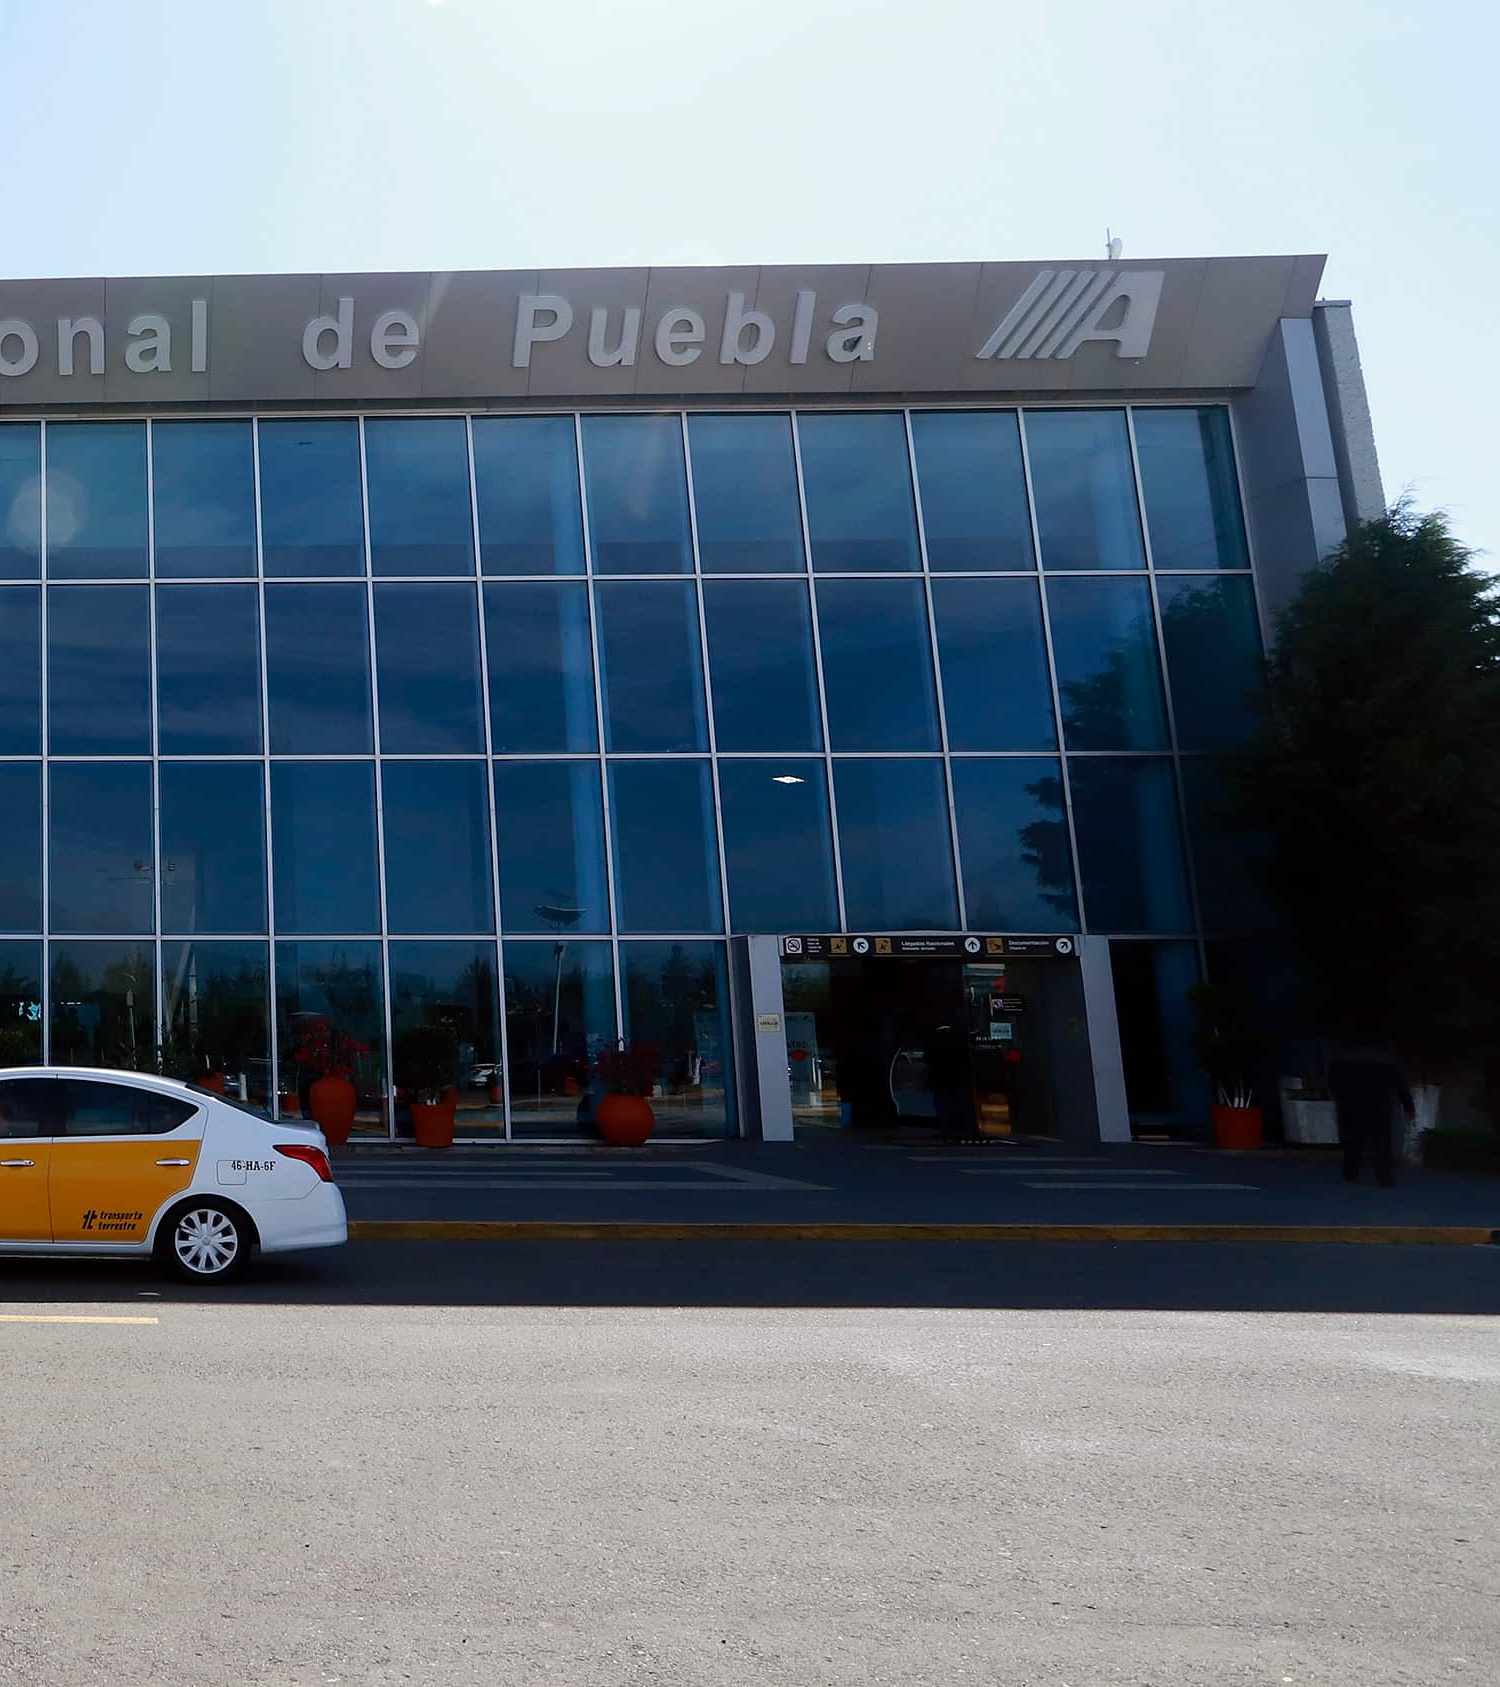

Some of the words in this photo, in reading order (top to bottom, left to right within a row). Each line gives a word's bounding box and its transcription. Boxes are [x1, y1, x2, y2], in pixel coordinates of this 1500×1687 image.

[301, 296, 421, 370] de
[512, 290, 880, 368] Puebla
[231, 1160, 277, 1171] 46-HA-6F
[100, 1210, 143, 1222] transporte
[98, 1221, 137, 1231] terrestre
